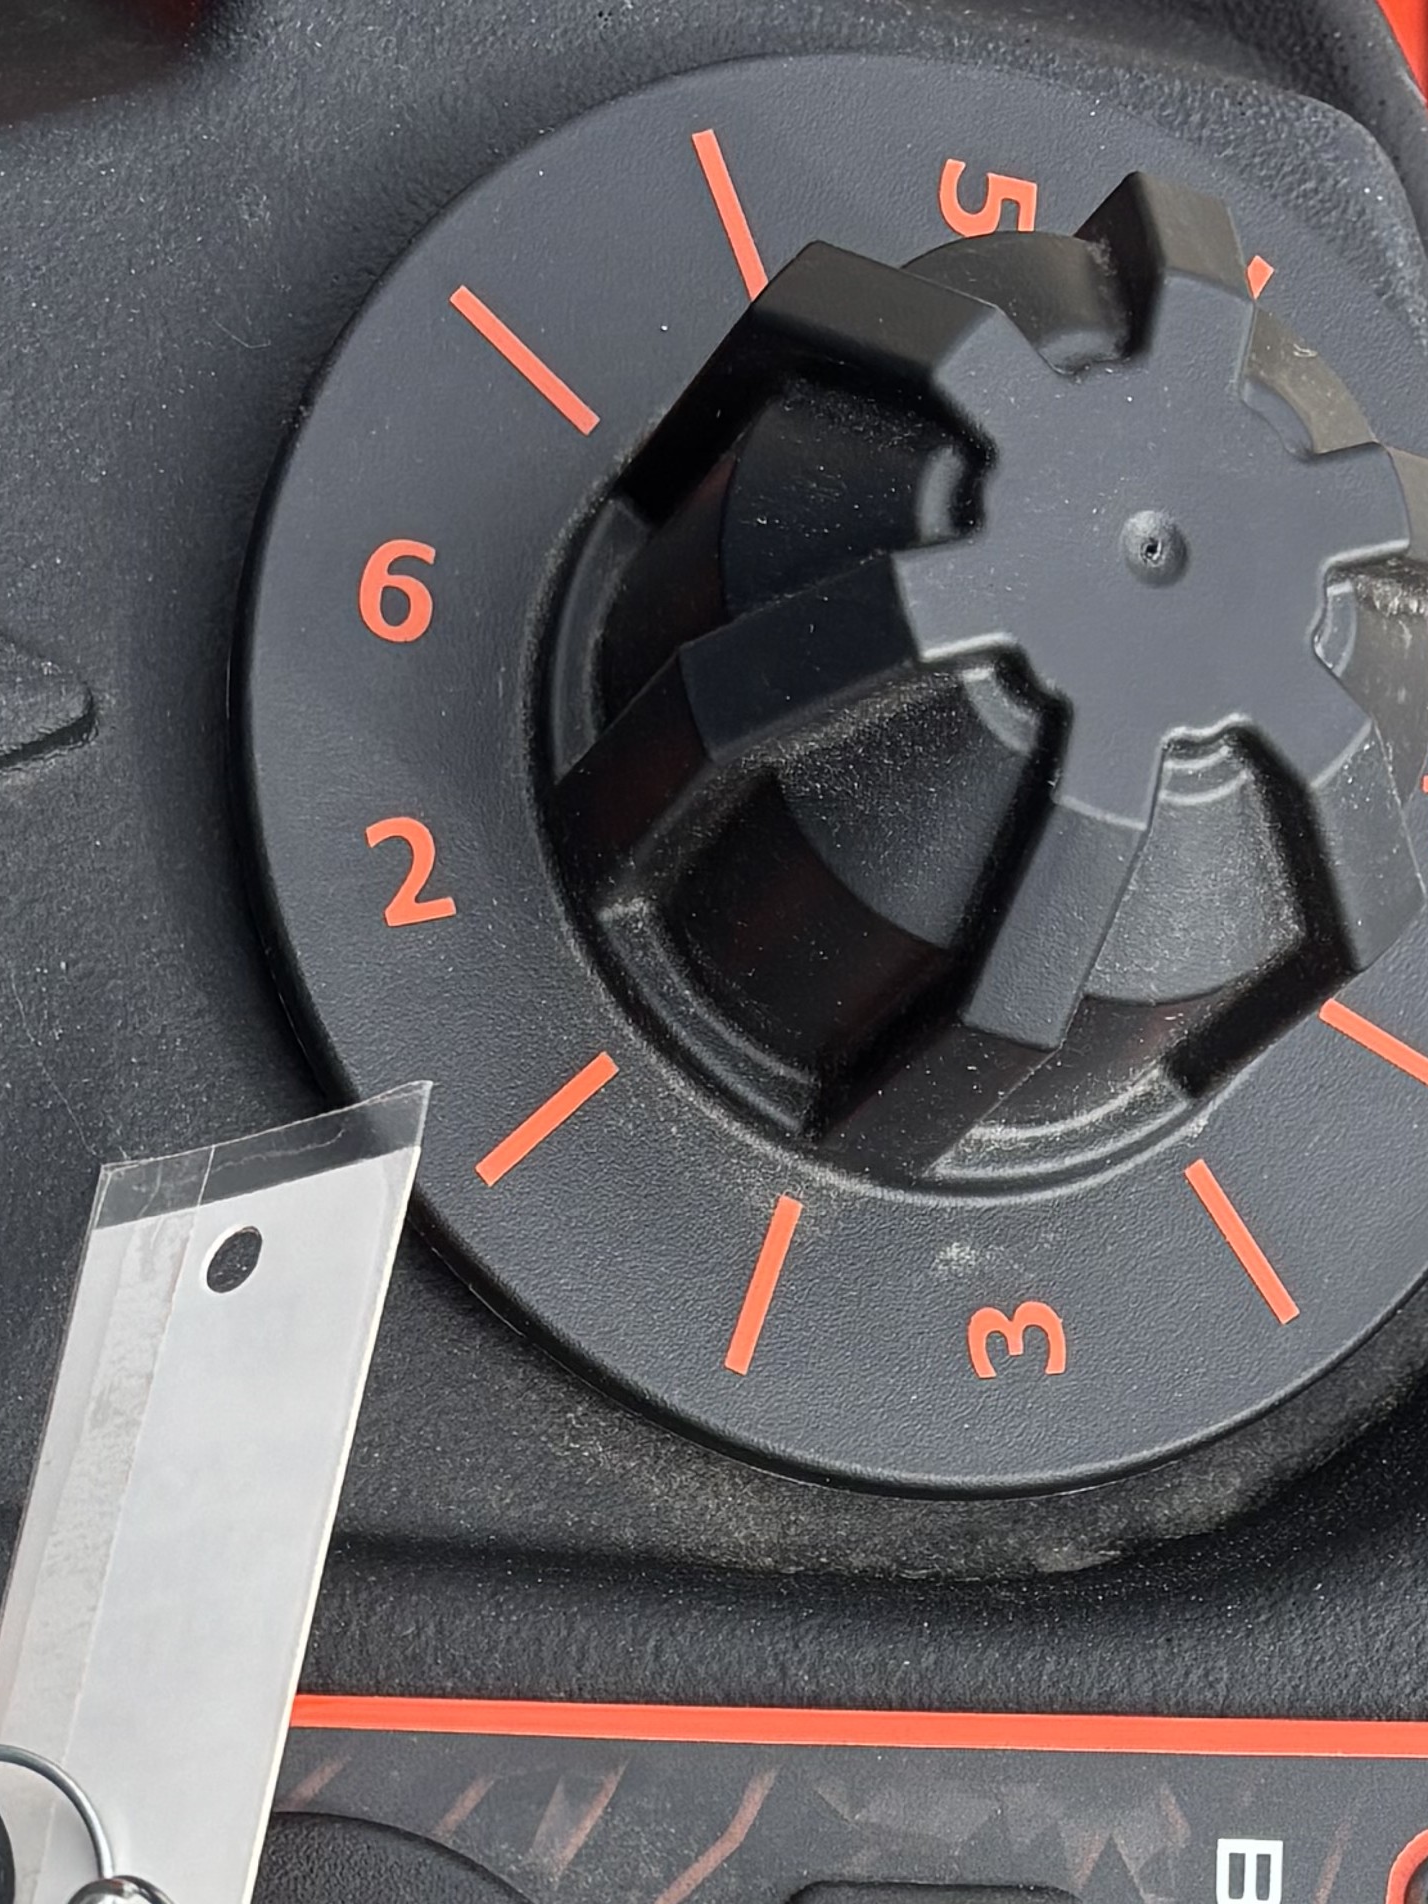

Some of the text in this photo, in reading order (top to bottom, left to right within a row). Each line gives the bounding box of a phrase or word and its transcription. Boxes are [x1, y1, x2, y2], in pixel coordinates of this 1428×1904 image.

[939, 158, 1038, 237] 5
[357, 538, 438, 642] 6
[364, 816, 458, 927] 2
[967, 1298, 1067, 1379] 3
